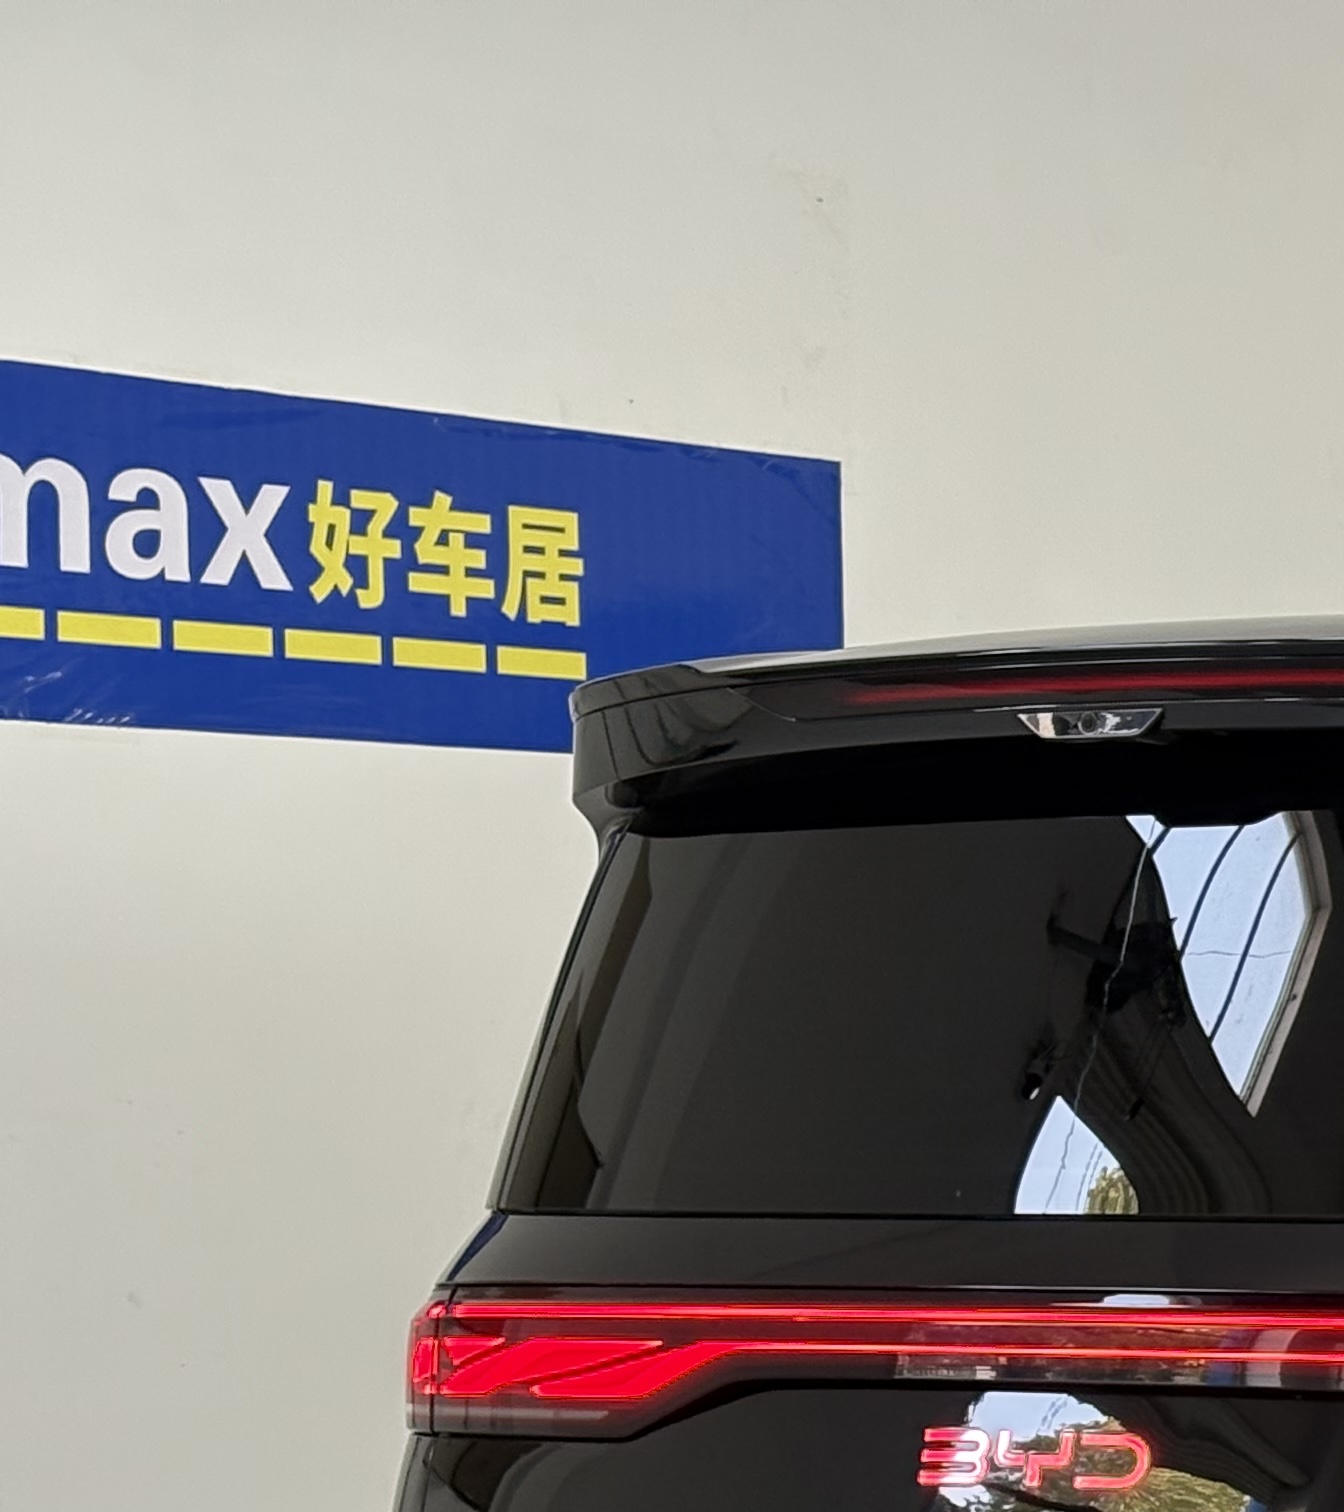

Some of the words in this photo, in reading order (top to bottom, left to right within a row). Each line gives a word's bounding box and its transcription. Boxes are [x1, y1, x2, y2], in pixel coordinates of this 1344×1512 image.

[308, 478, 585, 628] 好车居
[916, 1426, 1151, 1490] BYD
